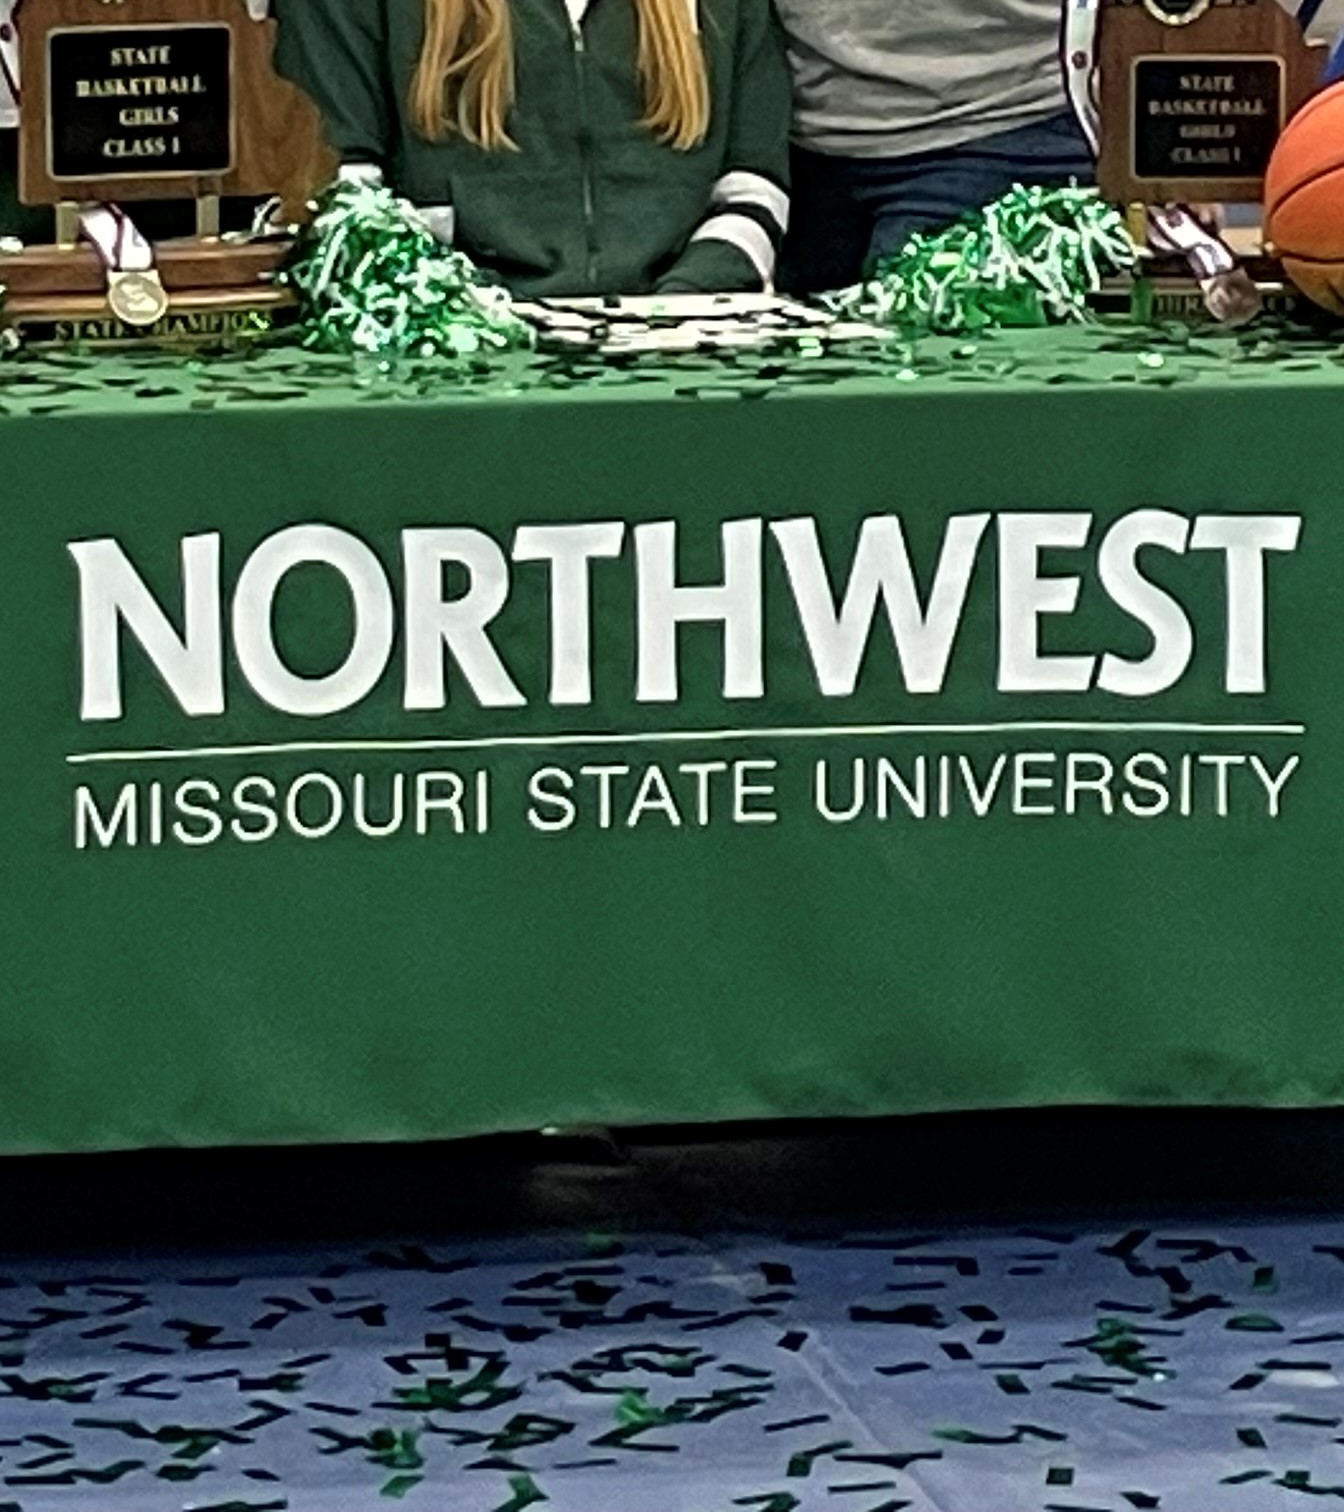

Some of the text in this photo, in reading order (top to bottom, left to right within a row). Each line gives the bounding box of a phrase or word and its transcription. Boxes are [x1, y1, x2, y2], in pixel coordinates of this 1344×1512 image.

[110, 45, 172, 67] STATE
[75, 74, 206, 98] BASKETBALL
[118, 106, 180, 127] GIRLS
[1147, 98, 1267, 117] BASKETBALL
[102, 137, 167, 158] CLASS
[66, 508, 1304, 721] NORTHWEST
[73, 750, 1301, 849] MISSOURI STATE UNIVERSITY
